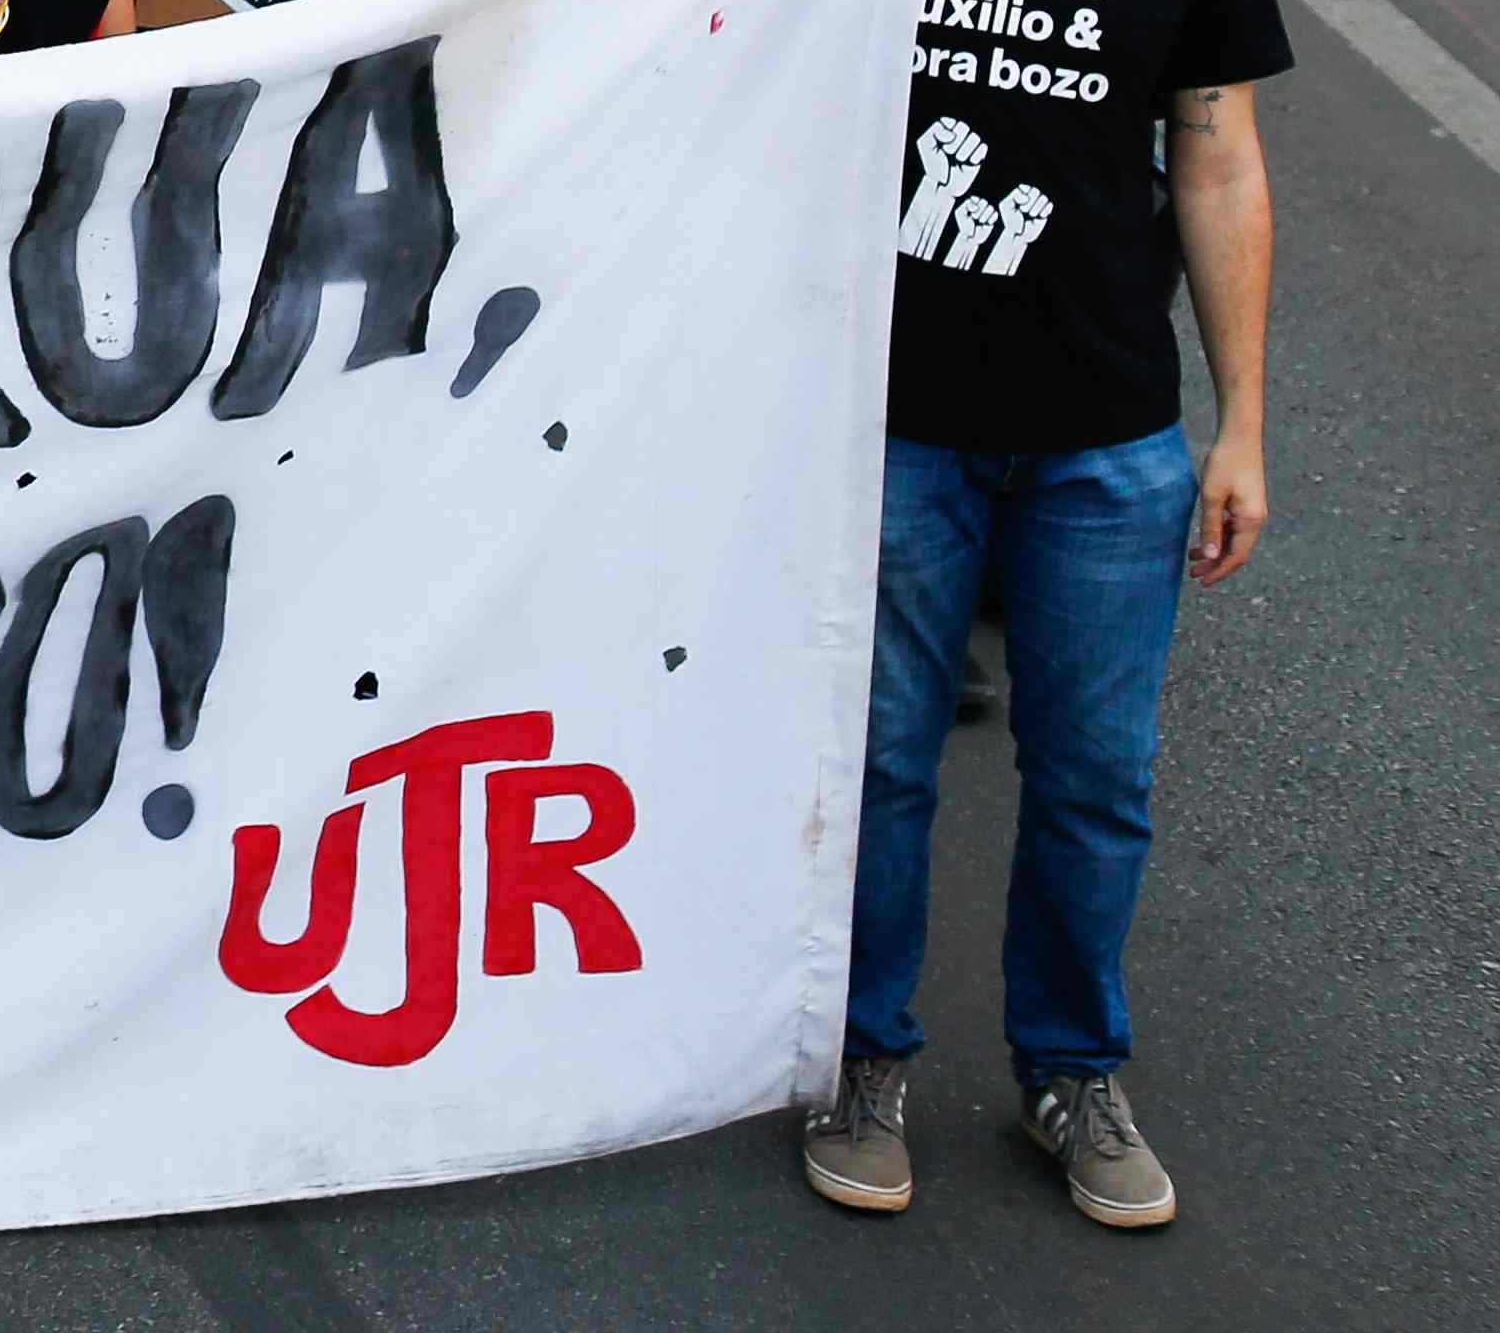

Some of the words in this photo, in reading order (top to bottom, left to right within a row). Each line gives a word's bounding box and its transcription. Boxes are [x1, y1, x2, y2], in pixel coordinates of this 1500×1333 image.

[1063, 7, 1103, 51] &
[911, 43, 979, 84] ora
[988, 46, 1110, 103] bozo
[216, 708, 646, 1068] UJR
